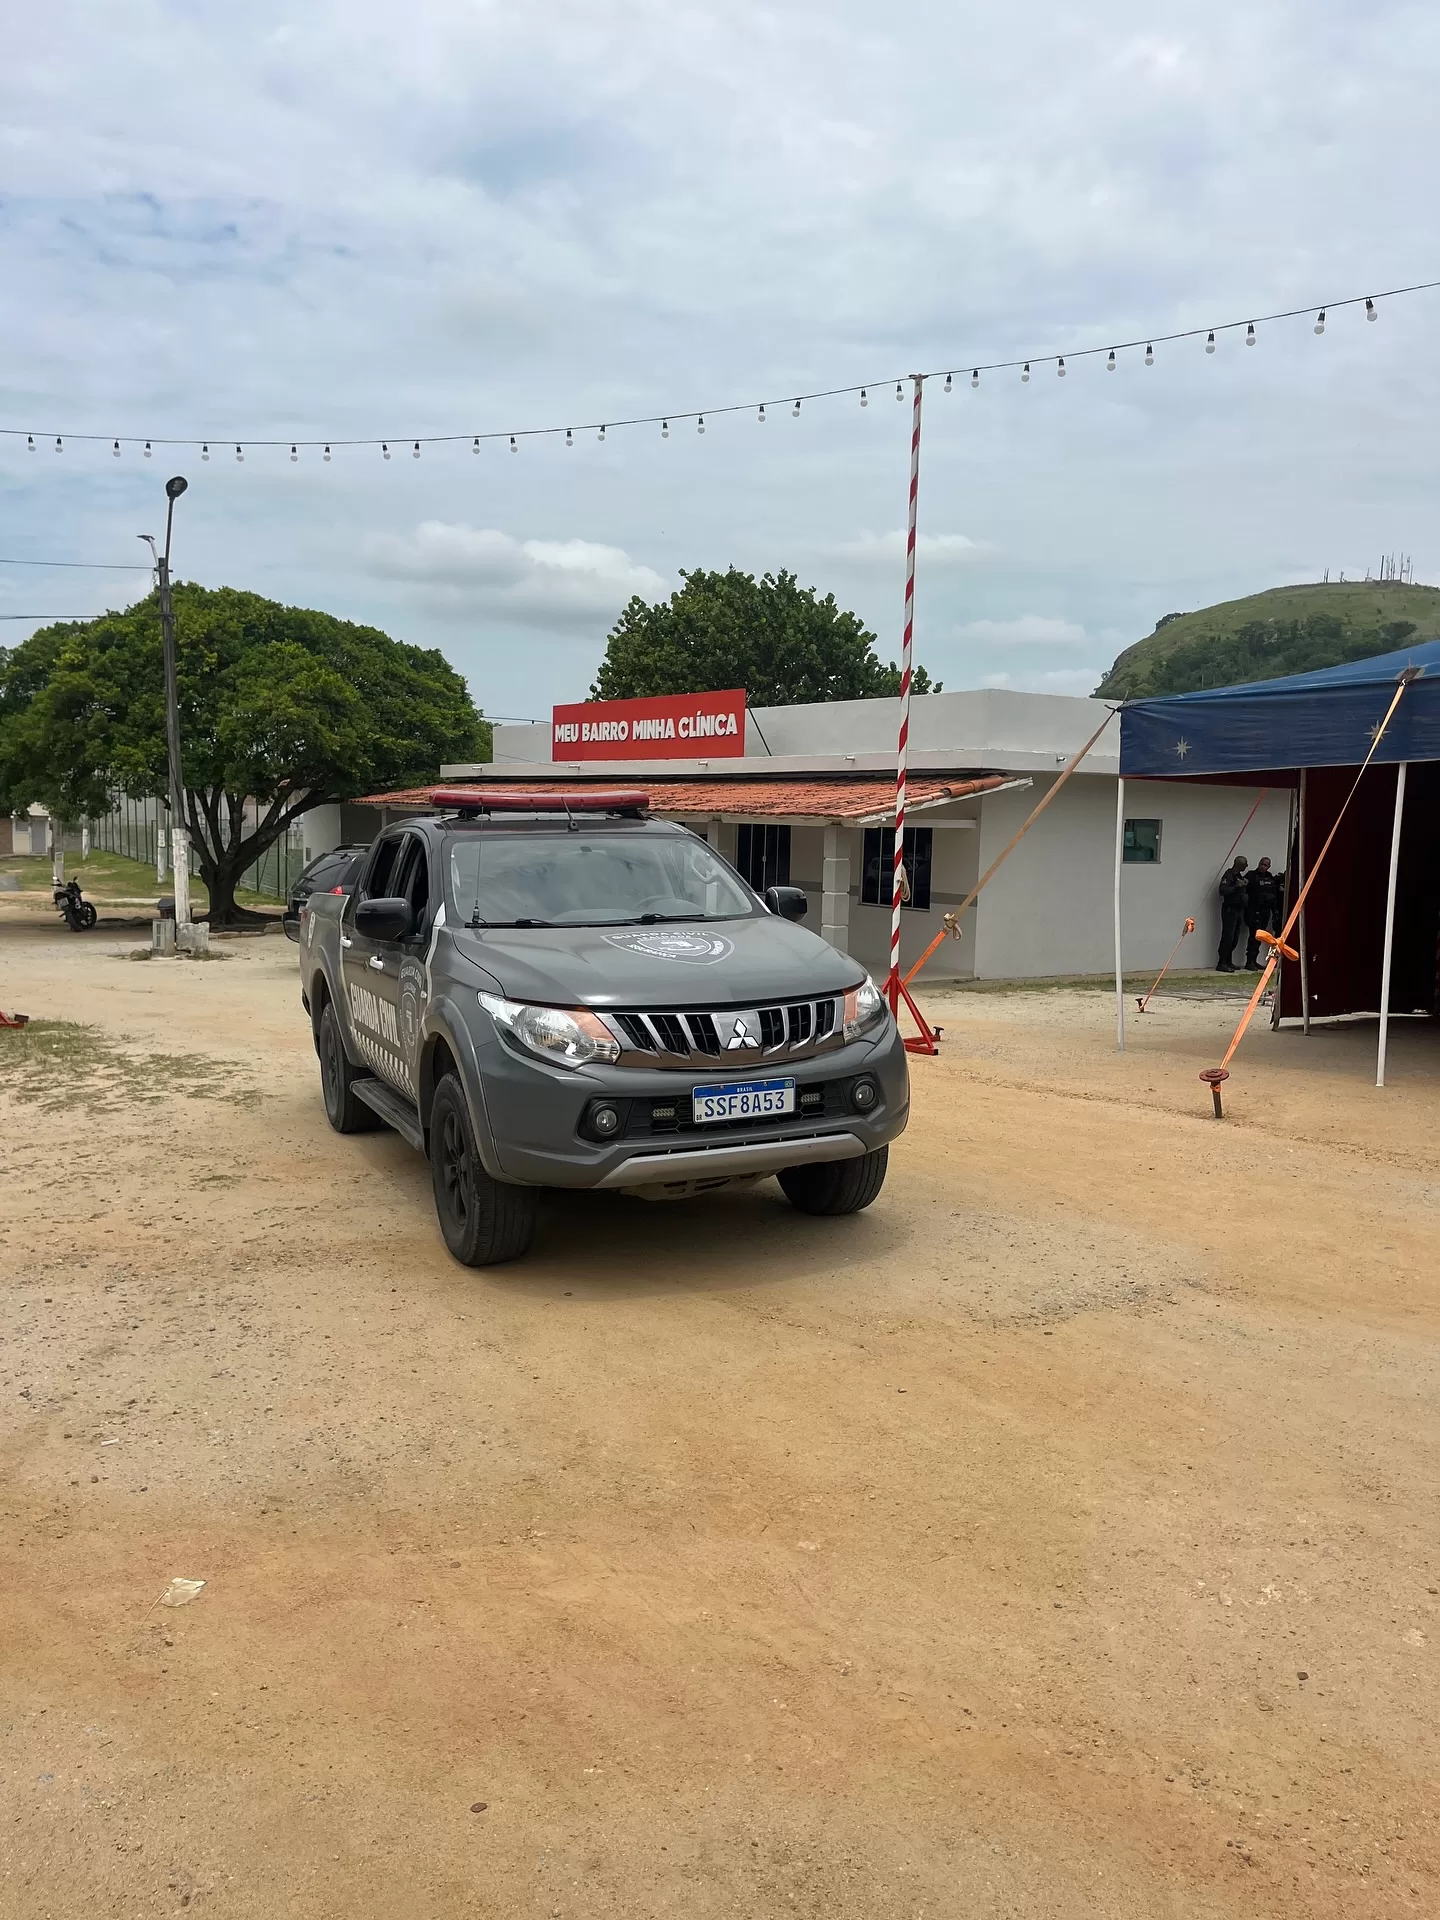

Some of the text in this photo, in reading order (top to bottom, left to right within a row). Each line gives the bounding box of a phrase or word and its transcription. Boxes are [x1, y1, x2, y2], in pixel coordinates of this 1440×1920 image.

[555, 710, 738, 743] MEU BAIRRO MINHA CLÍNICA
[350, 982, 381, 1035] GUARDA
[379, 997, 401, 1048] CIVIL
[704, 1091, 785, 1118] SSF8A53
